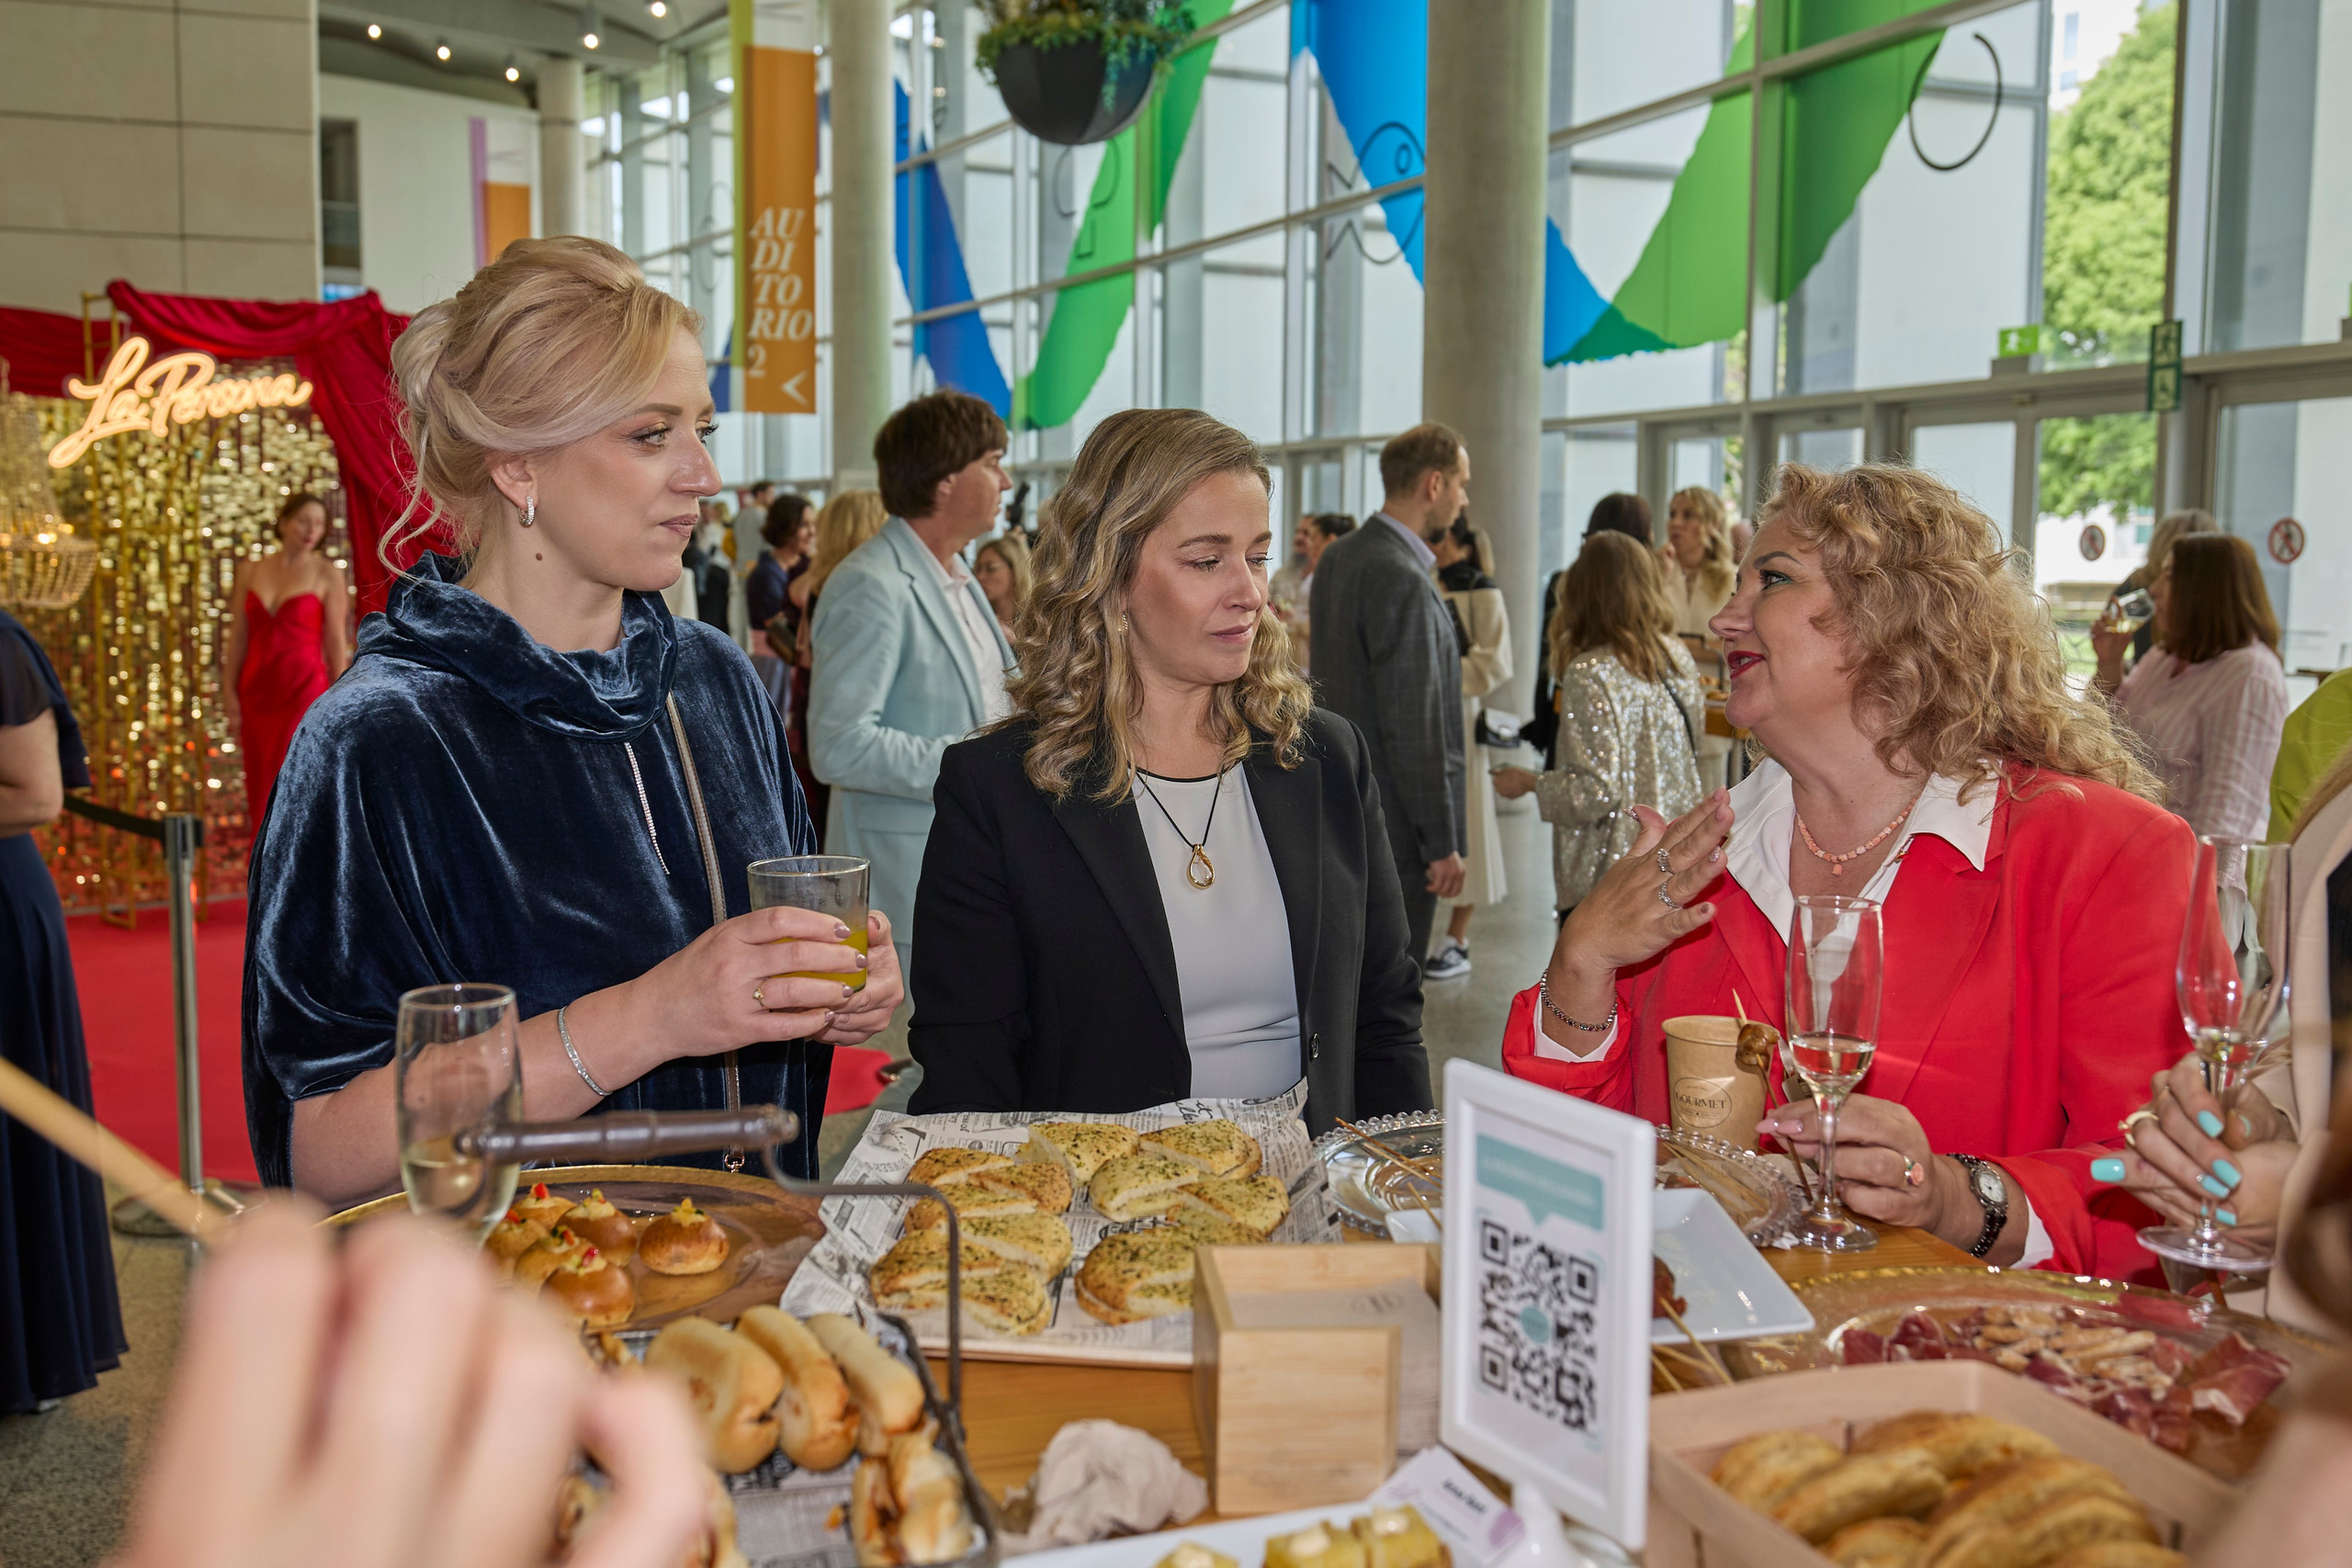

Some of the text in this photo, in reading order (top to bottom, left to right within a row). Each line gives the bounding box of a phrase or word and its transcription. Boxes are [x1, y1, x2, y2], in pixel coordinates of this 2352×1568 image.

[749, 207, 805, 240] AU
[751, 239, 796, 272] DI
[753, 273, 803, 306] TO
[747, 307, 814, 342] RIO
[747, 344, 767, 378] 2
[48, 336, 313, 468] La Persona
[1675, 1091, 1727, 1109] GOURMET
